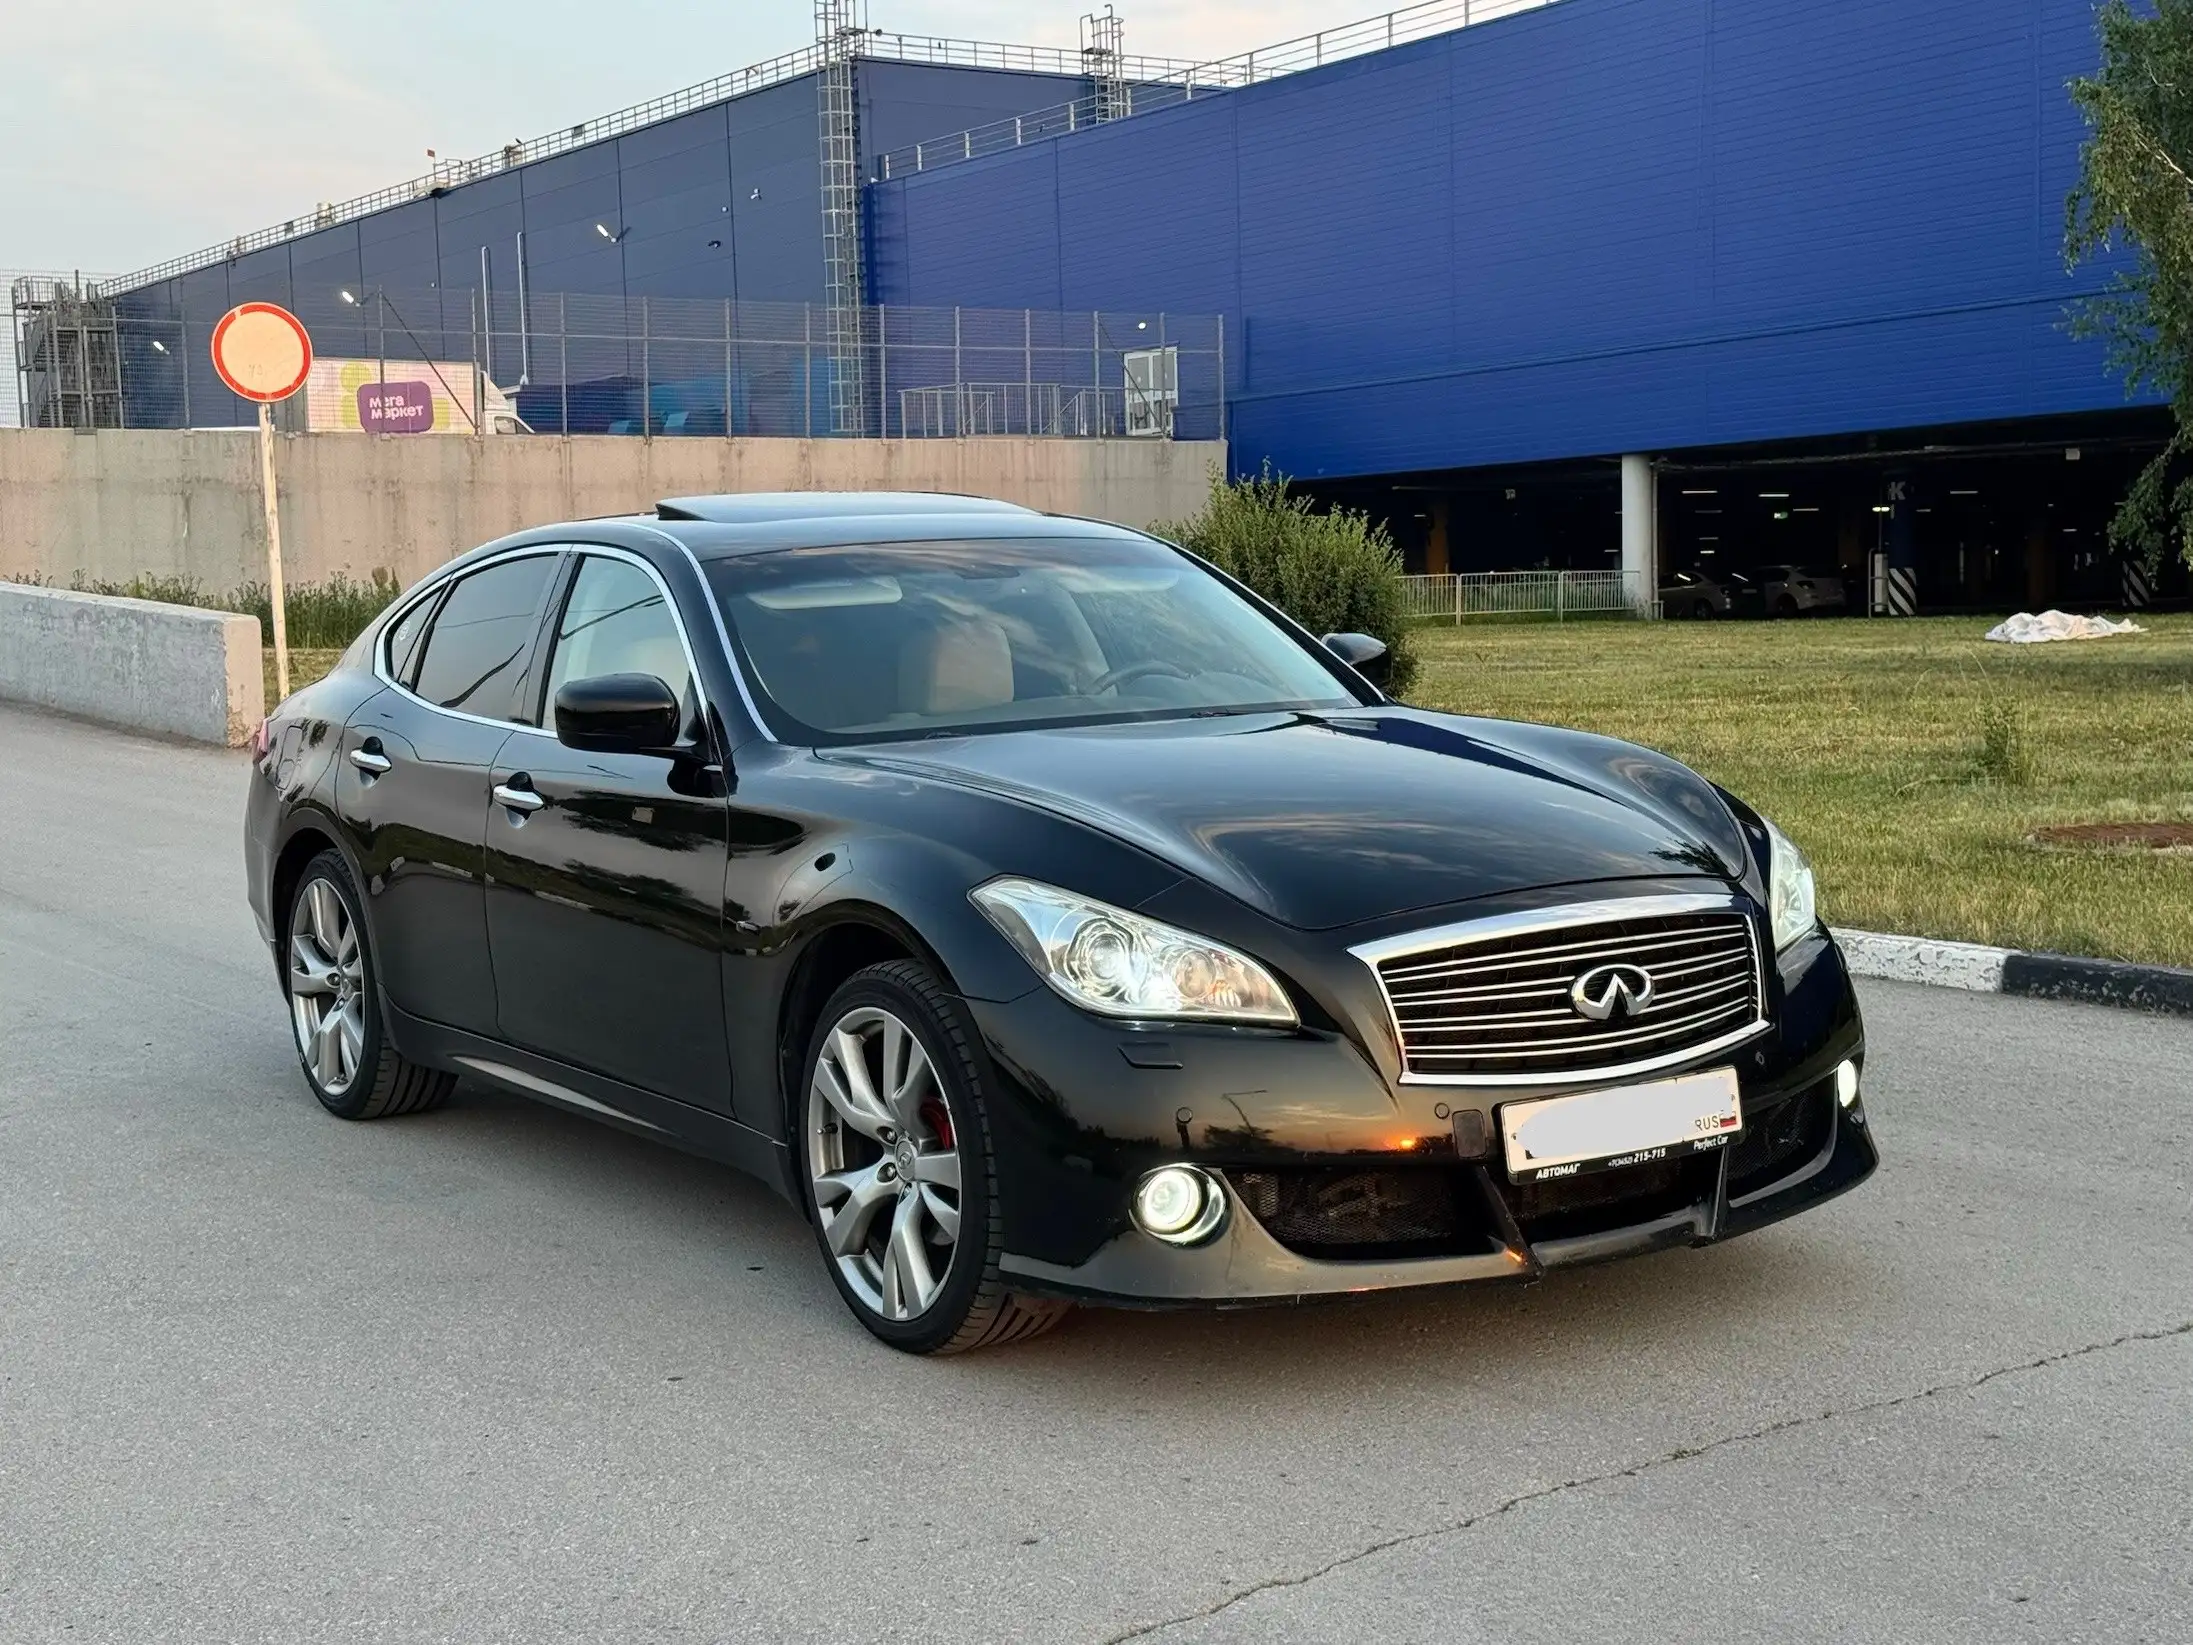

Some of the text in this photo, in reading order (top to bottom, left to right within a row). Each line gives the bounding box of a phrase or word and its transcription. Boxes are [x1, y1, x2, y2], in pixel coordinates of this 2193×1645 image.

[1694, 1115, 1719, 1131] RUS
[1693, 1135, 1729, 1151] Perfect Car
[1634, 1147, 1666, 1163] 215-715
[1536, 1163, 1581, 1180] АВТОМАГ
